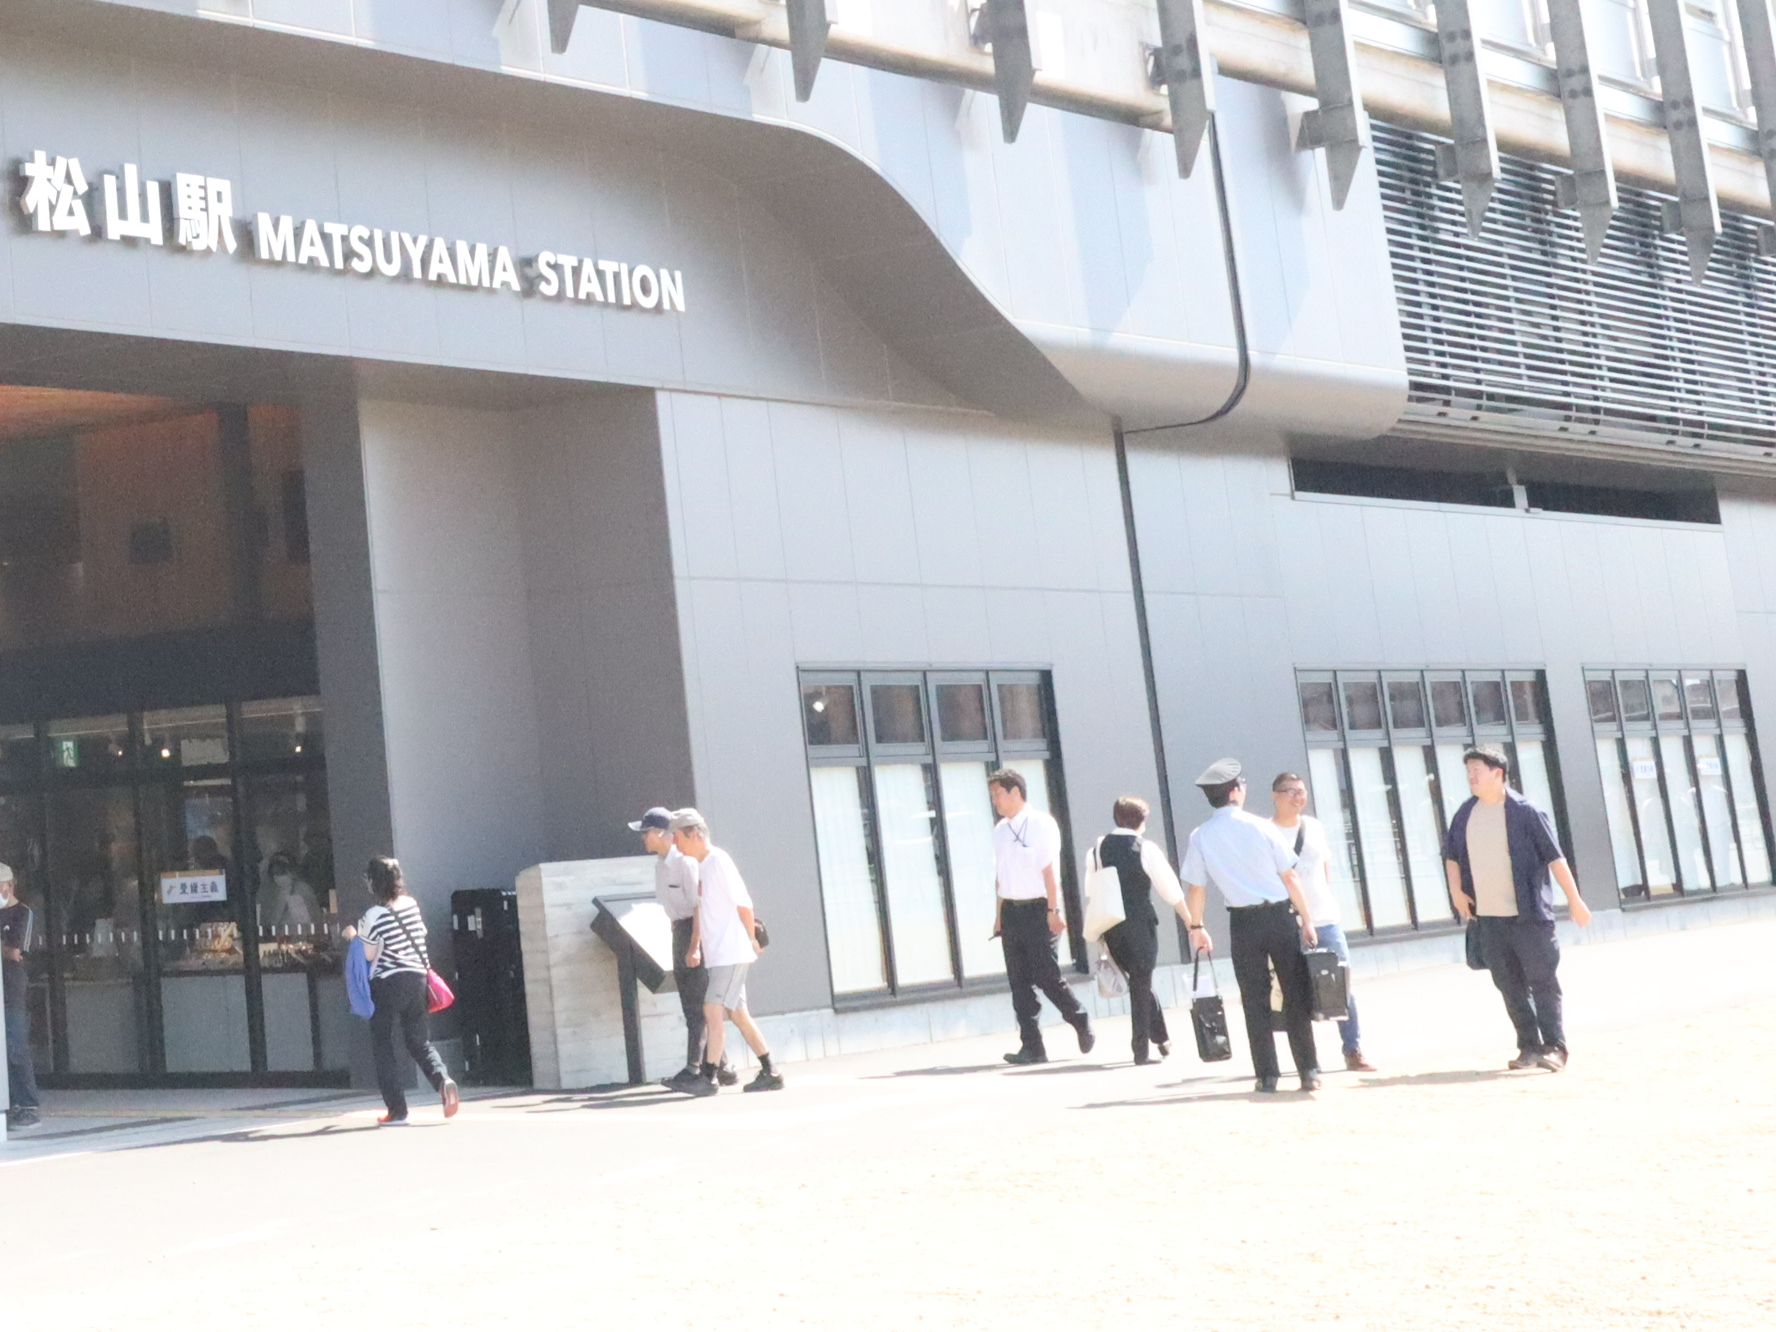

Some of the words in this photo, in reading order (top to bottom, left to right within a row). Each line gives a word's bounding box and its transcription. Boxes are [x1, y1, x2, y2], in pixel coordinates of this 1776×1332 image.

[22, 149, 238, 255] 松山駅
[256, 210, 522, 293] MATSUYAMA
[537, 249, 687, 313] STATION
